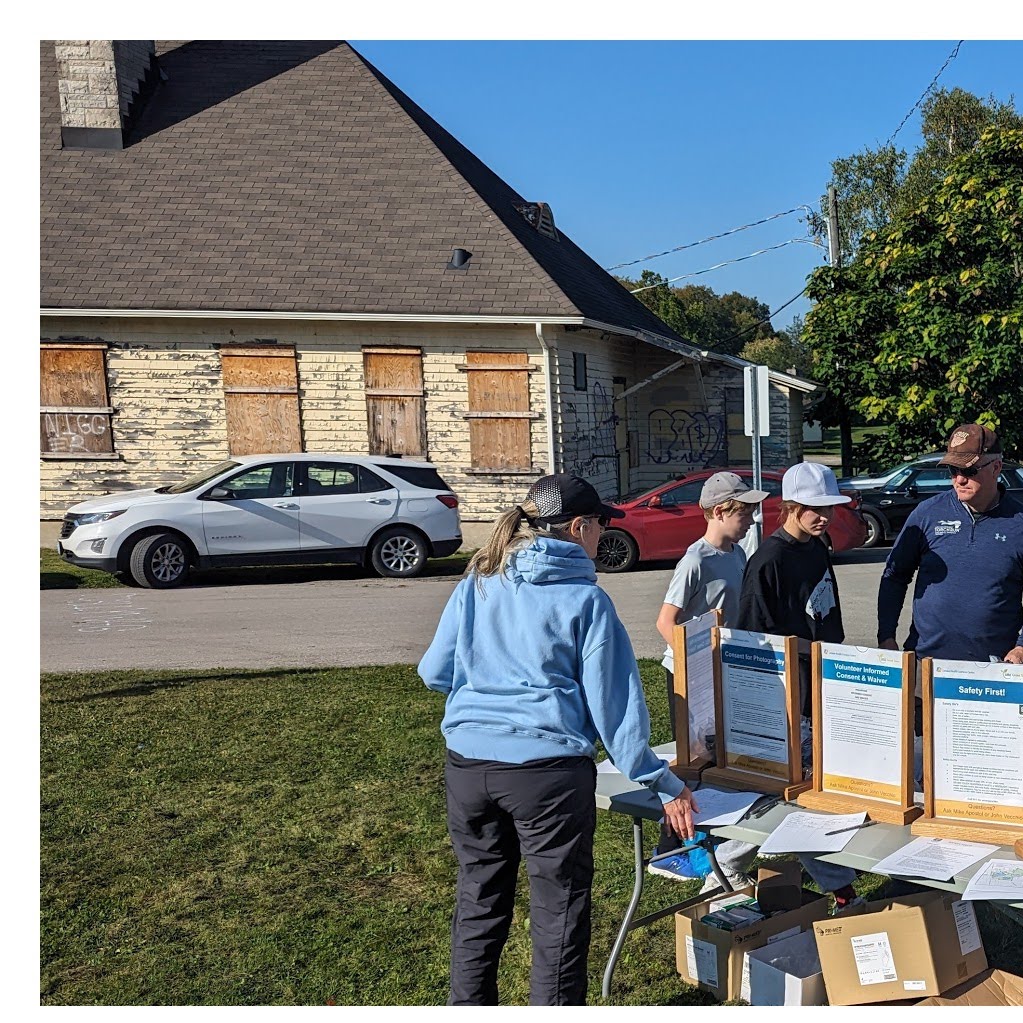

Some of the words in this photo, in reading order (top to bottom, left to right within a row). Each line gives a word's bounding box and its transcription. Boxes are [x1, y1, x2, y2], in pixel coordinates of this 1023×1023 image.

[45, 413, 106, 438] NIGG
[724, 650, 745, 659] Consent
[753, 655, 785, 667] Photography
[834, 663, 862, 672] Volunteer
[863, 666, 890, 676] Informed
[836, 672, 860, 681] Consent
[867, 675, 888, 684] Waiver
[958, 685, 983, 696] Safety
[984, 687, 1006, 697] First!
[967, 803, 996, 811] Questions?
